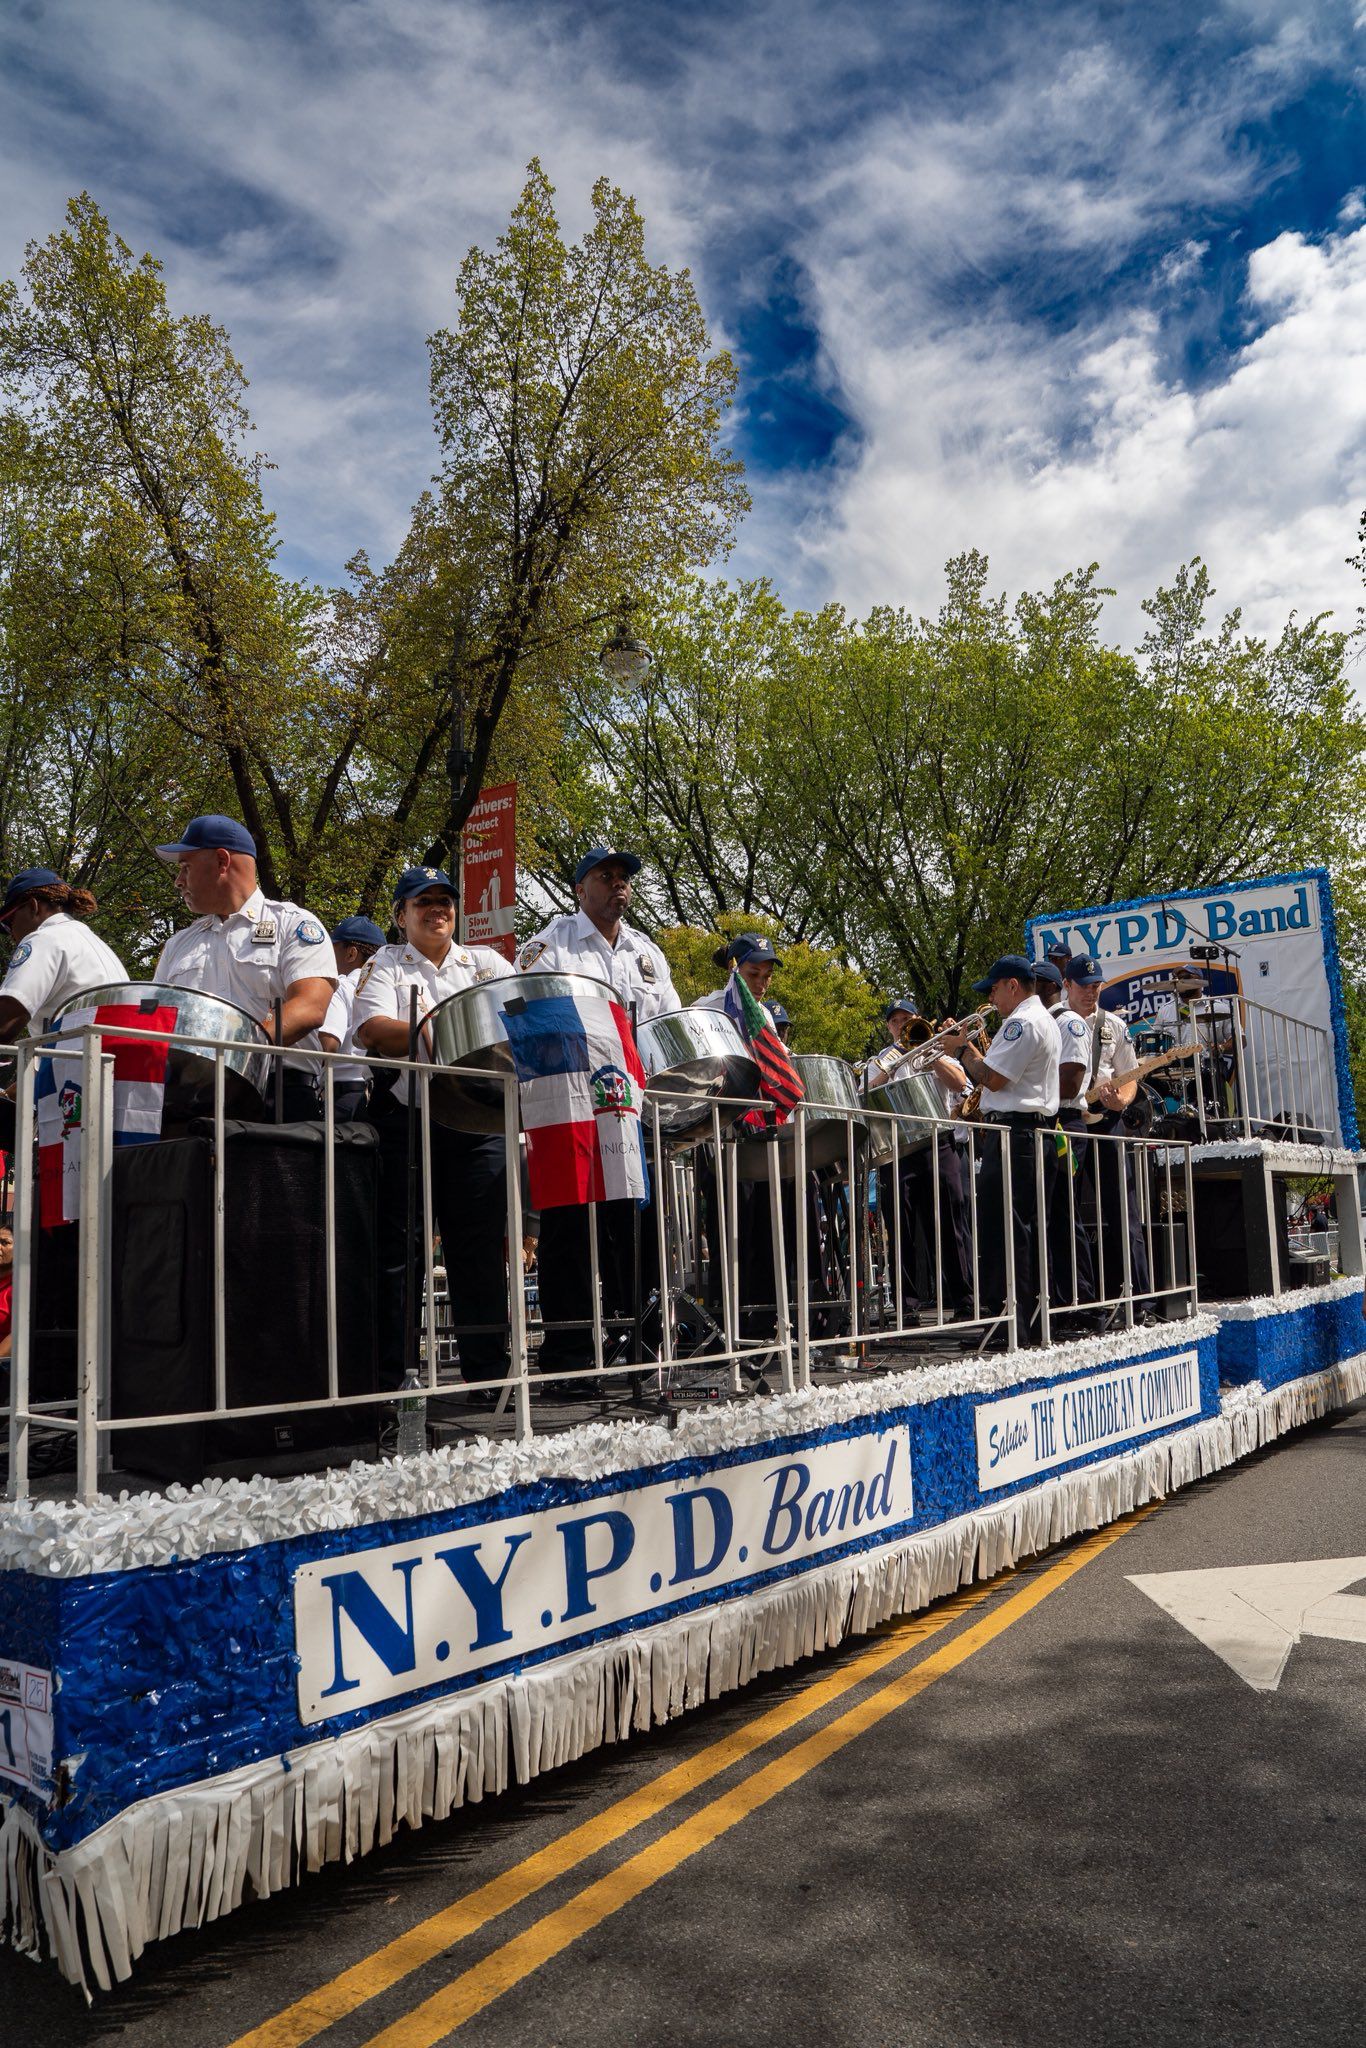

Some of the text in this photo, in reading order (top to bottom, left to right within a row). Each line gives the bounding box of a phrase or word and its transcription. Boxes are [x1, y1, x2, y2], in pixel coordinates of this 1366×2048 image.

[466, 816, 499, 832] Protect
[466, 848, 503, 864] Children
[468, 916, 490, 927] Slow
[1203, 887, 1311, 942] Band
[468, 926, 493, 939] Down
[989, 1360, 1193, 1469] Salutes THE CARRIBBEAN COMMUNITY
[320, 1439, 898, 1698] N.Y.P.D. Band
